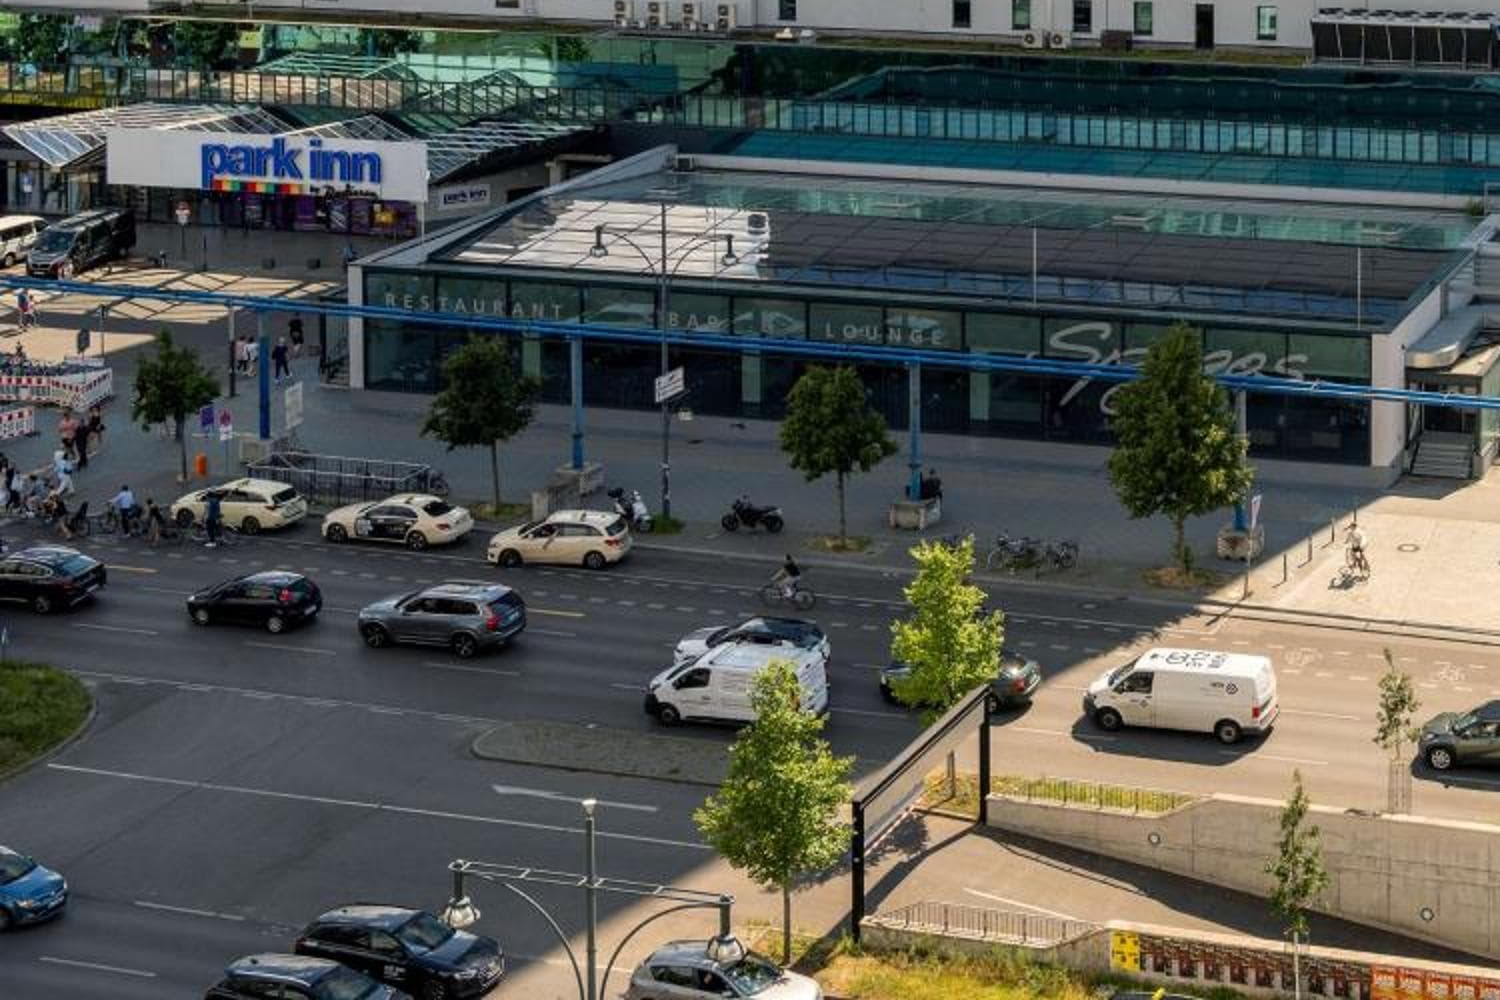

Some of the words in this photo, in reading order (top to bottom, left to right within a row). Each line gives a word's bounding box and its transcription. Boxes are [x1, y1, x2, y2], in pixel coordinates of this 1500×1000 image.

[201, 138, 303, 190] park
[309, 139, 382, 185] inn
[384, 293, 562, 319] RESTAURANT
[825, 322, 945, 345] LOUNGE
